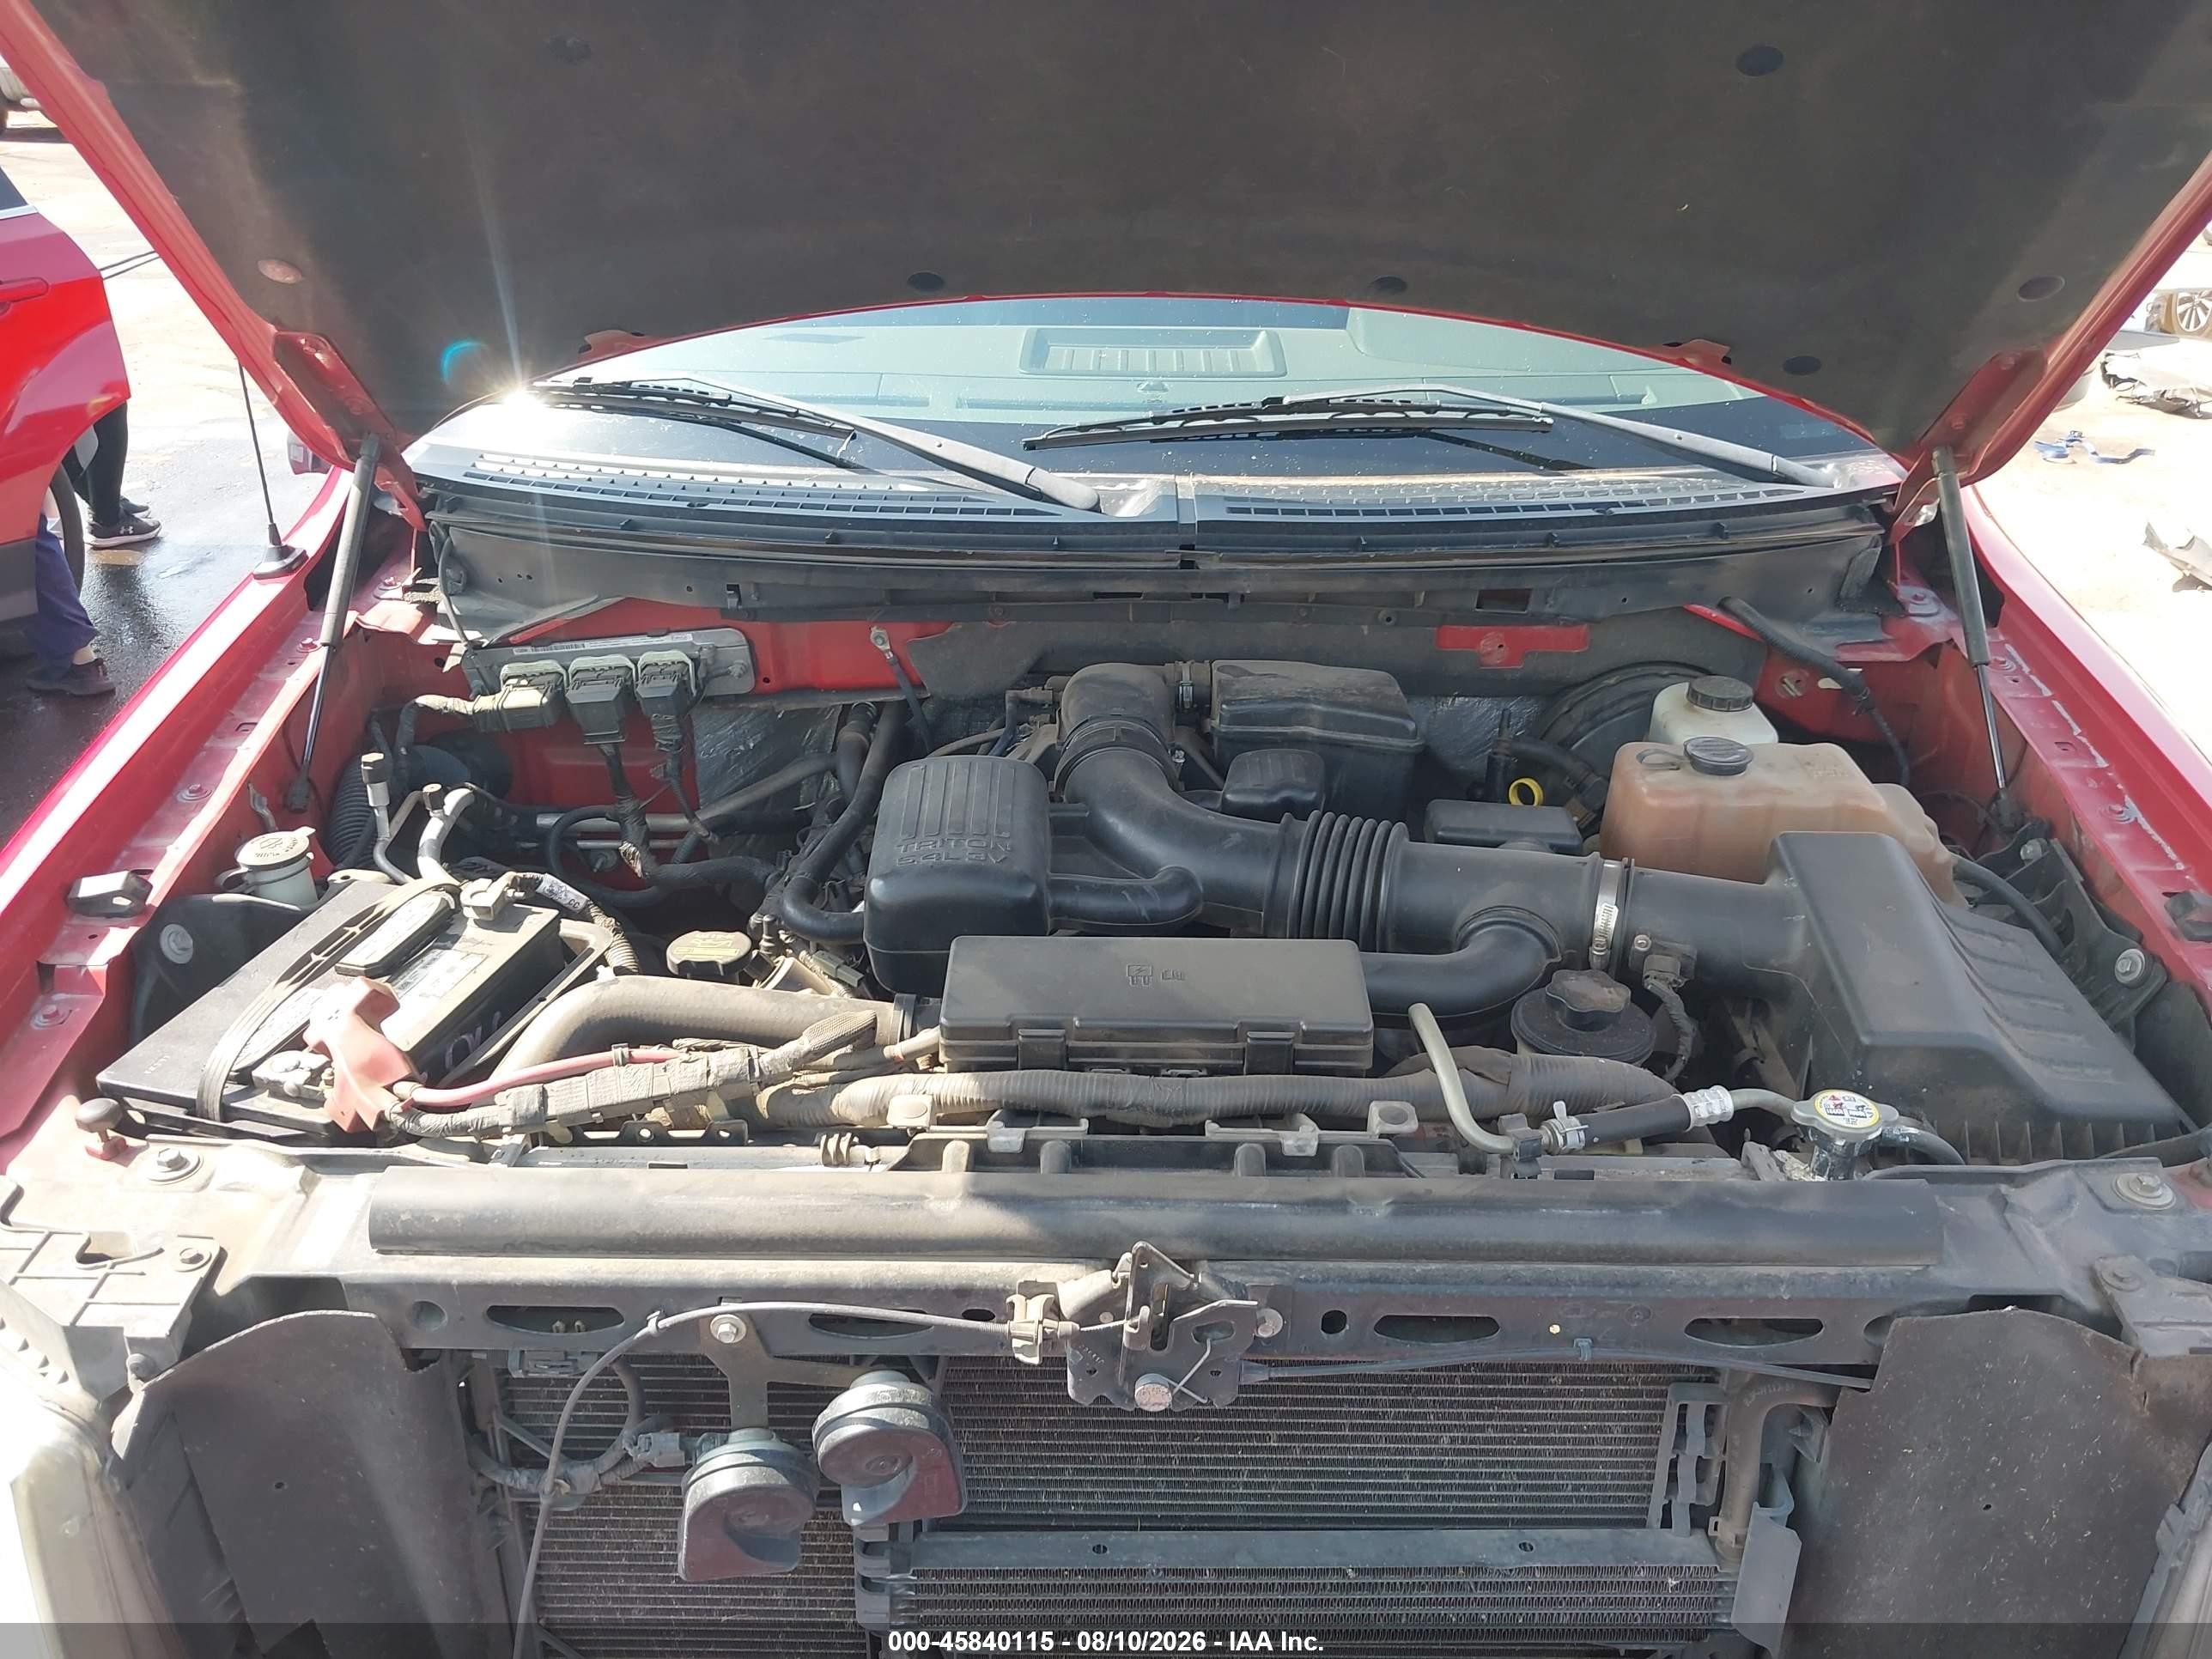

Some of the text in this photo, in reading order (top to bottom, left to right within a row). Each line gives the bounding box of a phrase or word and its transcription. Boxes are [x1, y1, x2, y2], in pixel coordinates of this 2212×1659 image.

[896, 837, 1012, 853] TRITON
[896, 852, 1008, 866] 5.4L 3V
